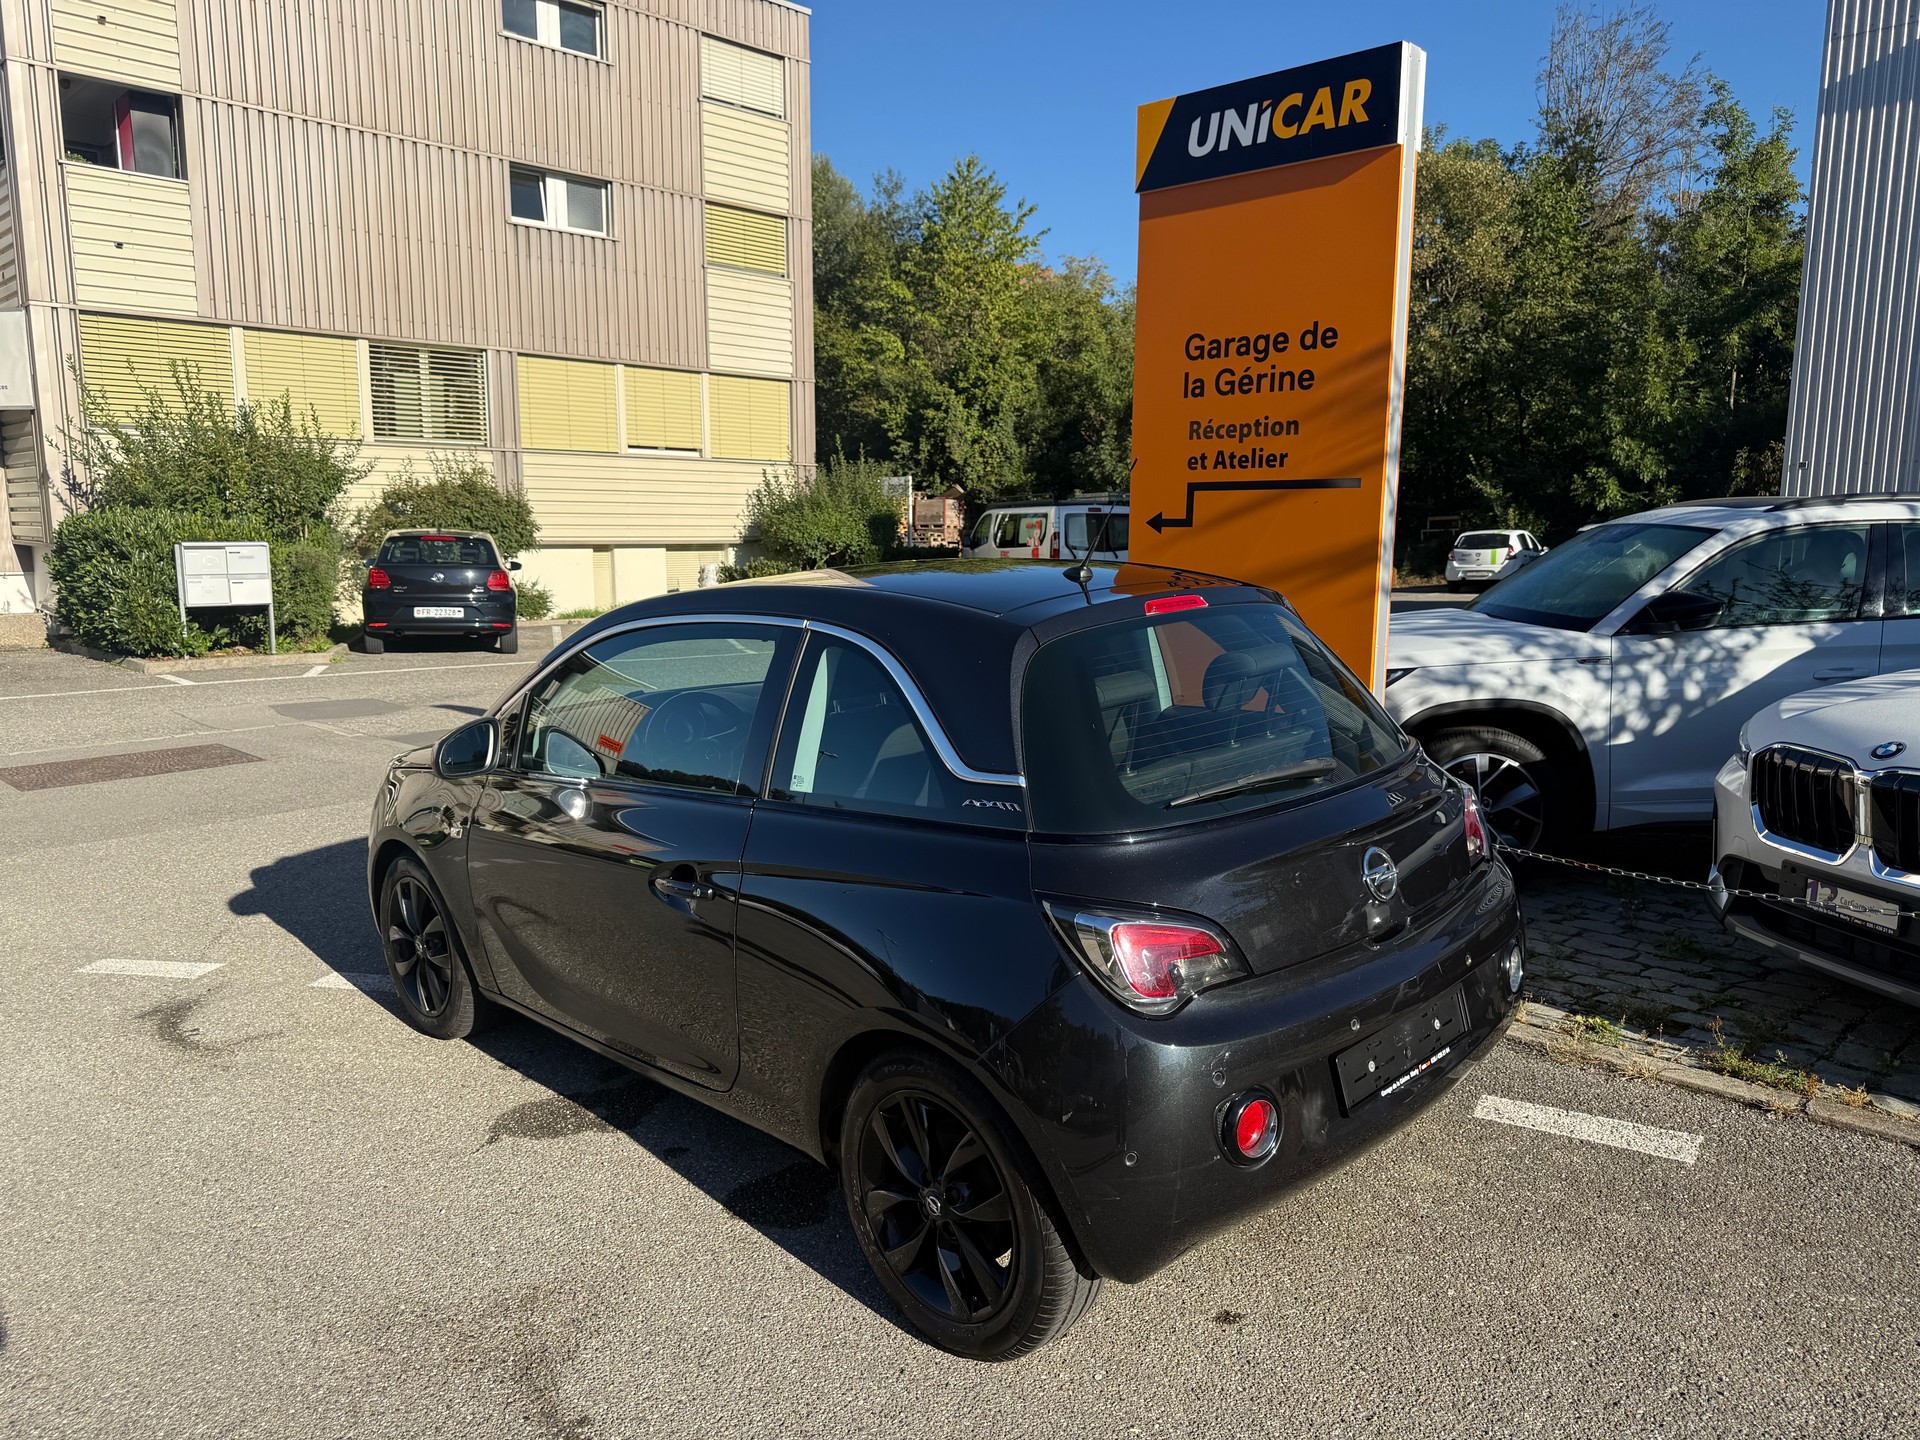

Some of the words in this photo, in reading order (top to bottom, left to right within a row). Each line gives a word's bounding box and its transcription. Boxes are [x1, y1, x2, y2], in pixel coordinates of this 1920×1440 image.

[1184, 332, 1290, 363] Garage
[1299, 320, 1339, 351] de
[1183, 371, 1206, 399] la
[1214, 364, 1315, 396] Gérine
[1188, 415, 1300, 444] Réception
[1187, 452, 1208, 471] et
[1212, 447, 1289, 471] Atelier
